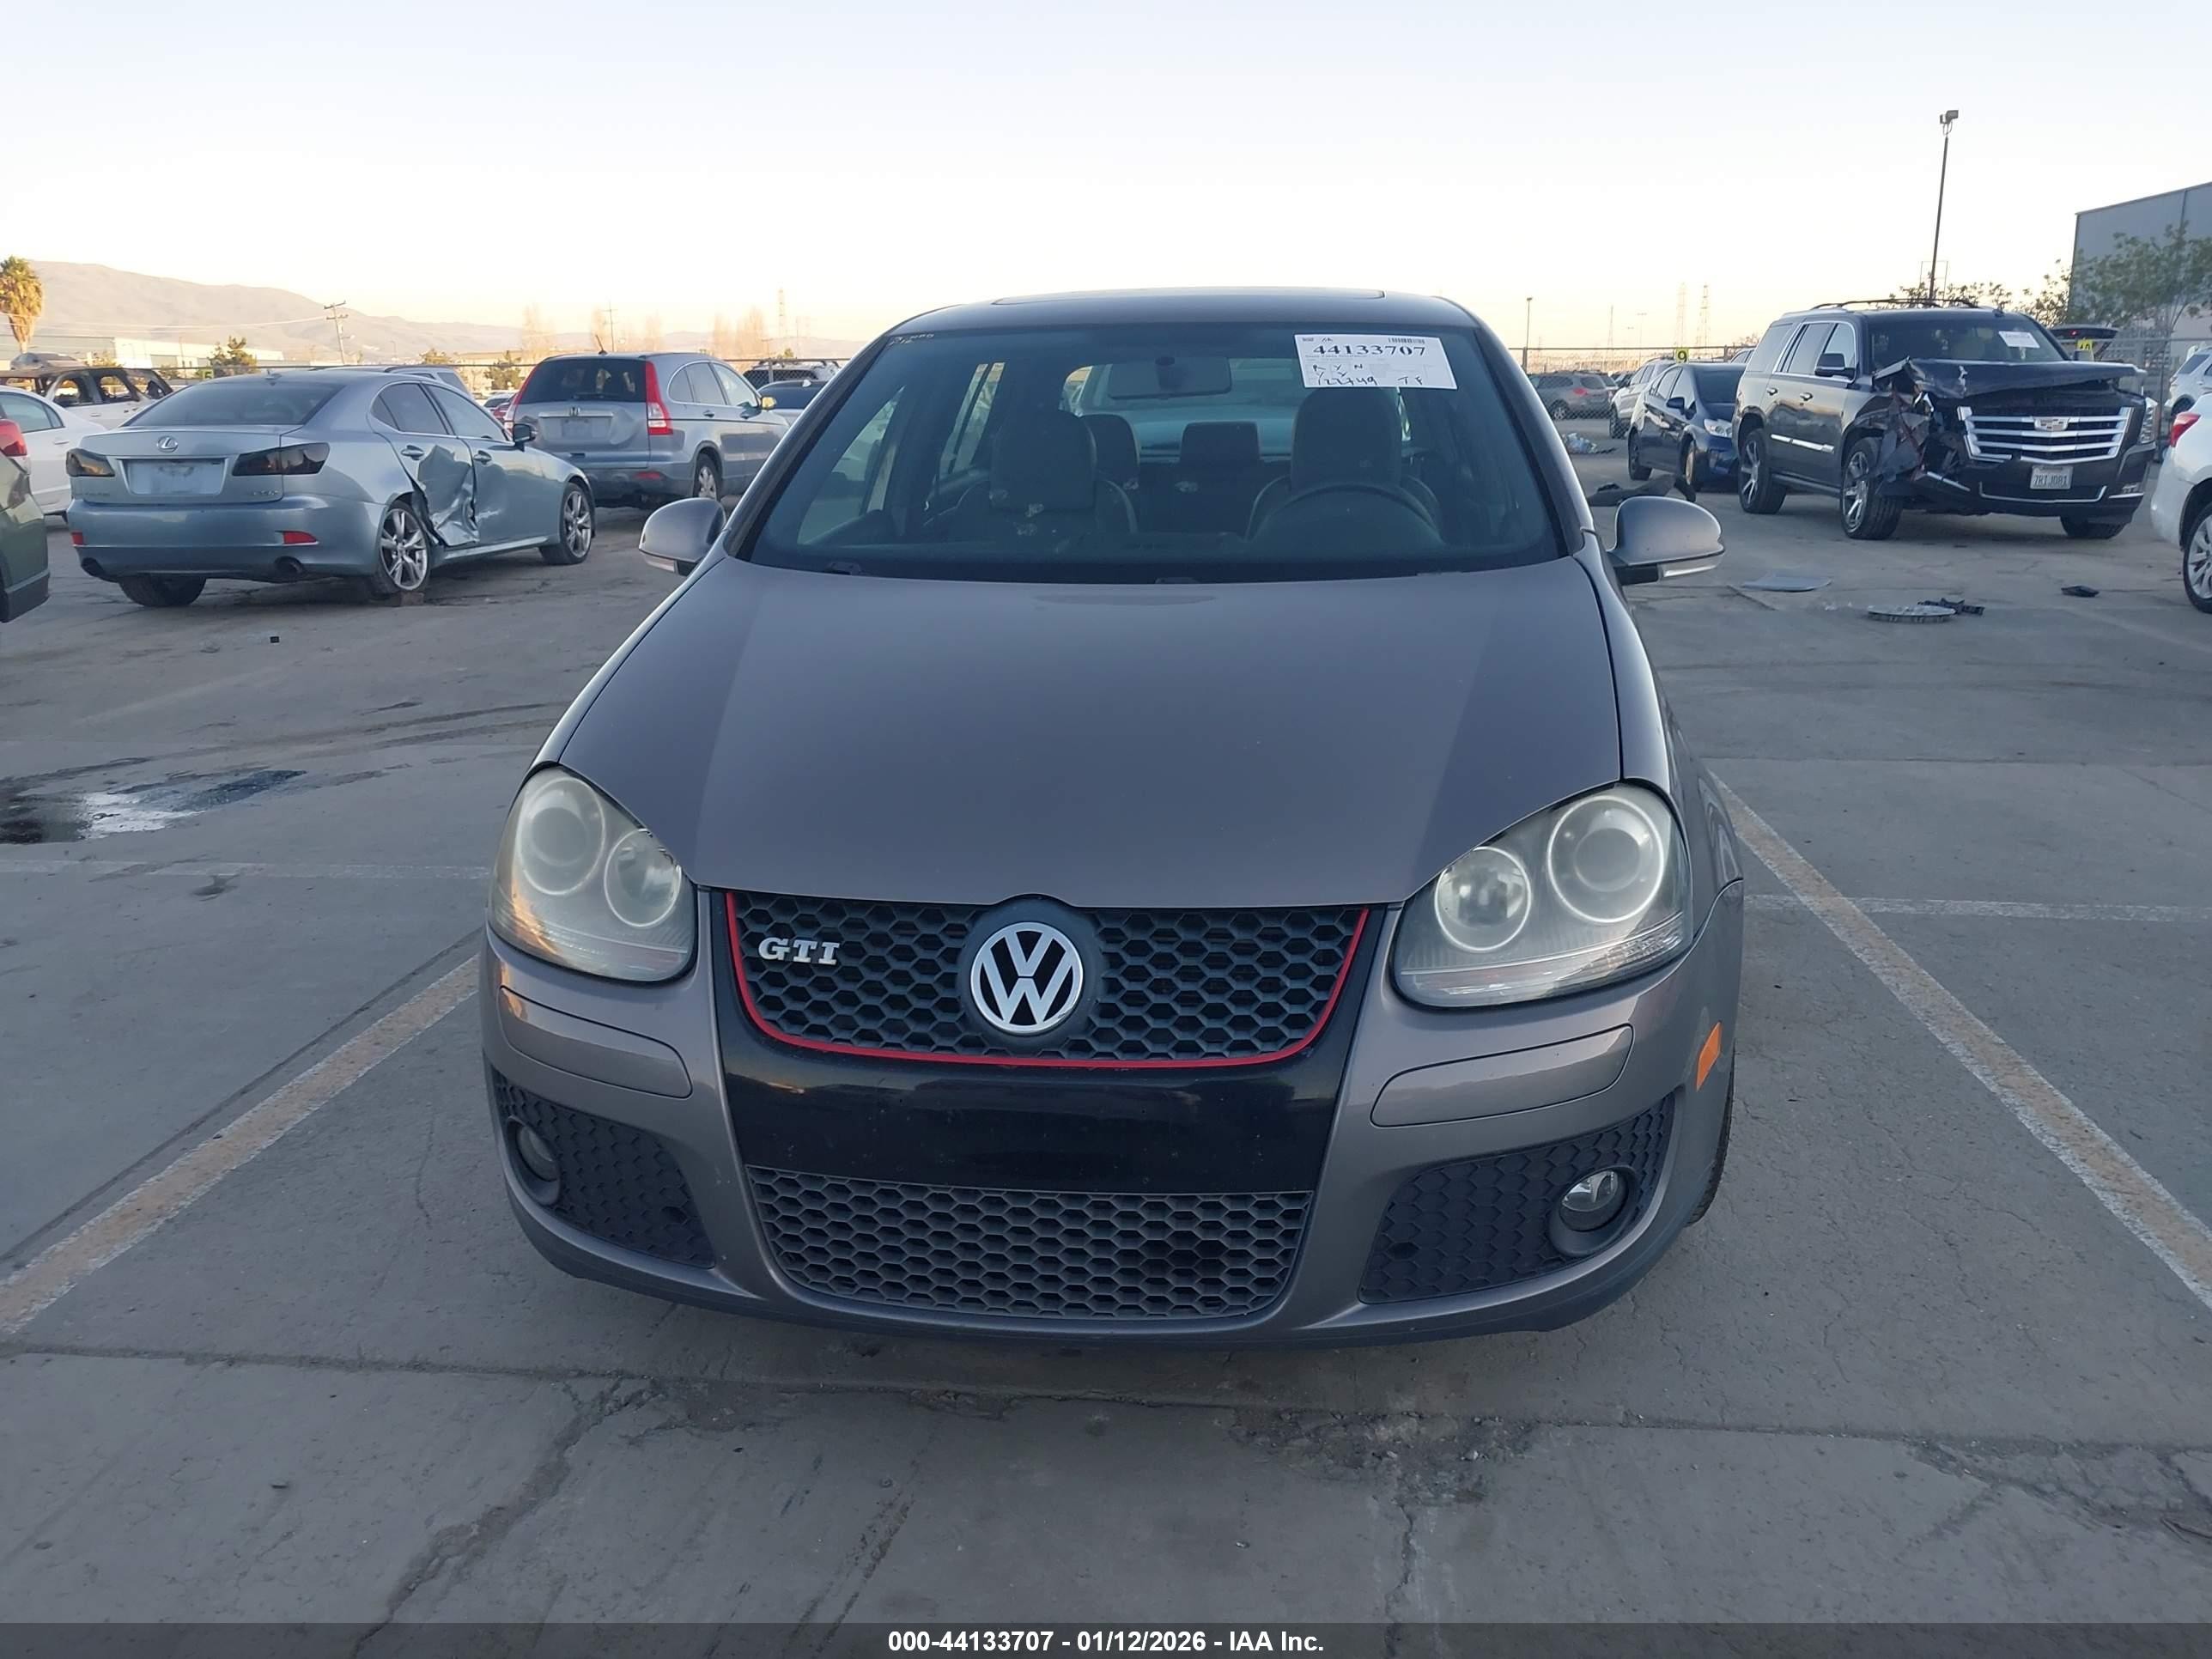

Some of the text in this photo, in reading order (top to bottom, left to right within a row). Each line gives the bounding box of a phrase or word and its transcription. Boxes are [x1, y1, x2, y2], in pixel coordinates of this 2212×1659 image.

[1313, 345, 1425, 356] 44133707
[1677, 350, 1687, 363] 9
[757, 937, 840, 965] GTI
